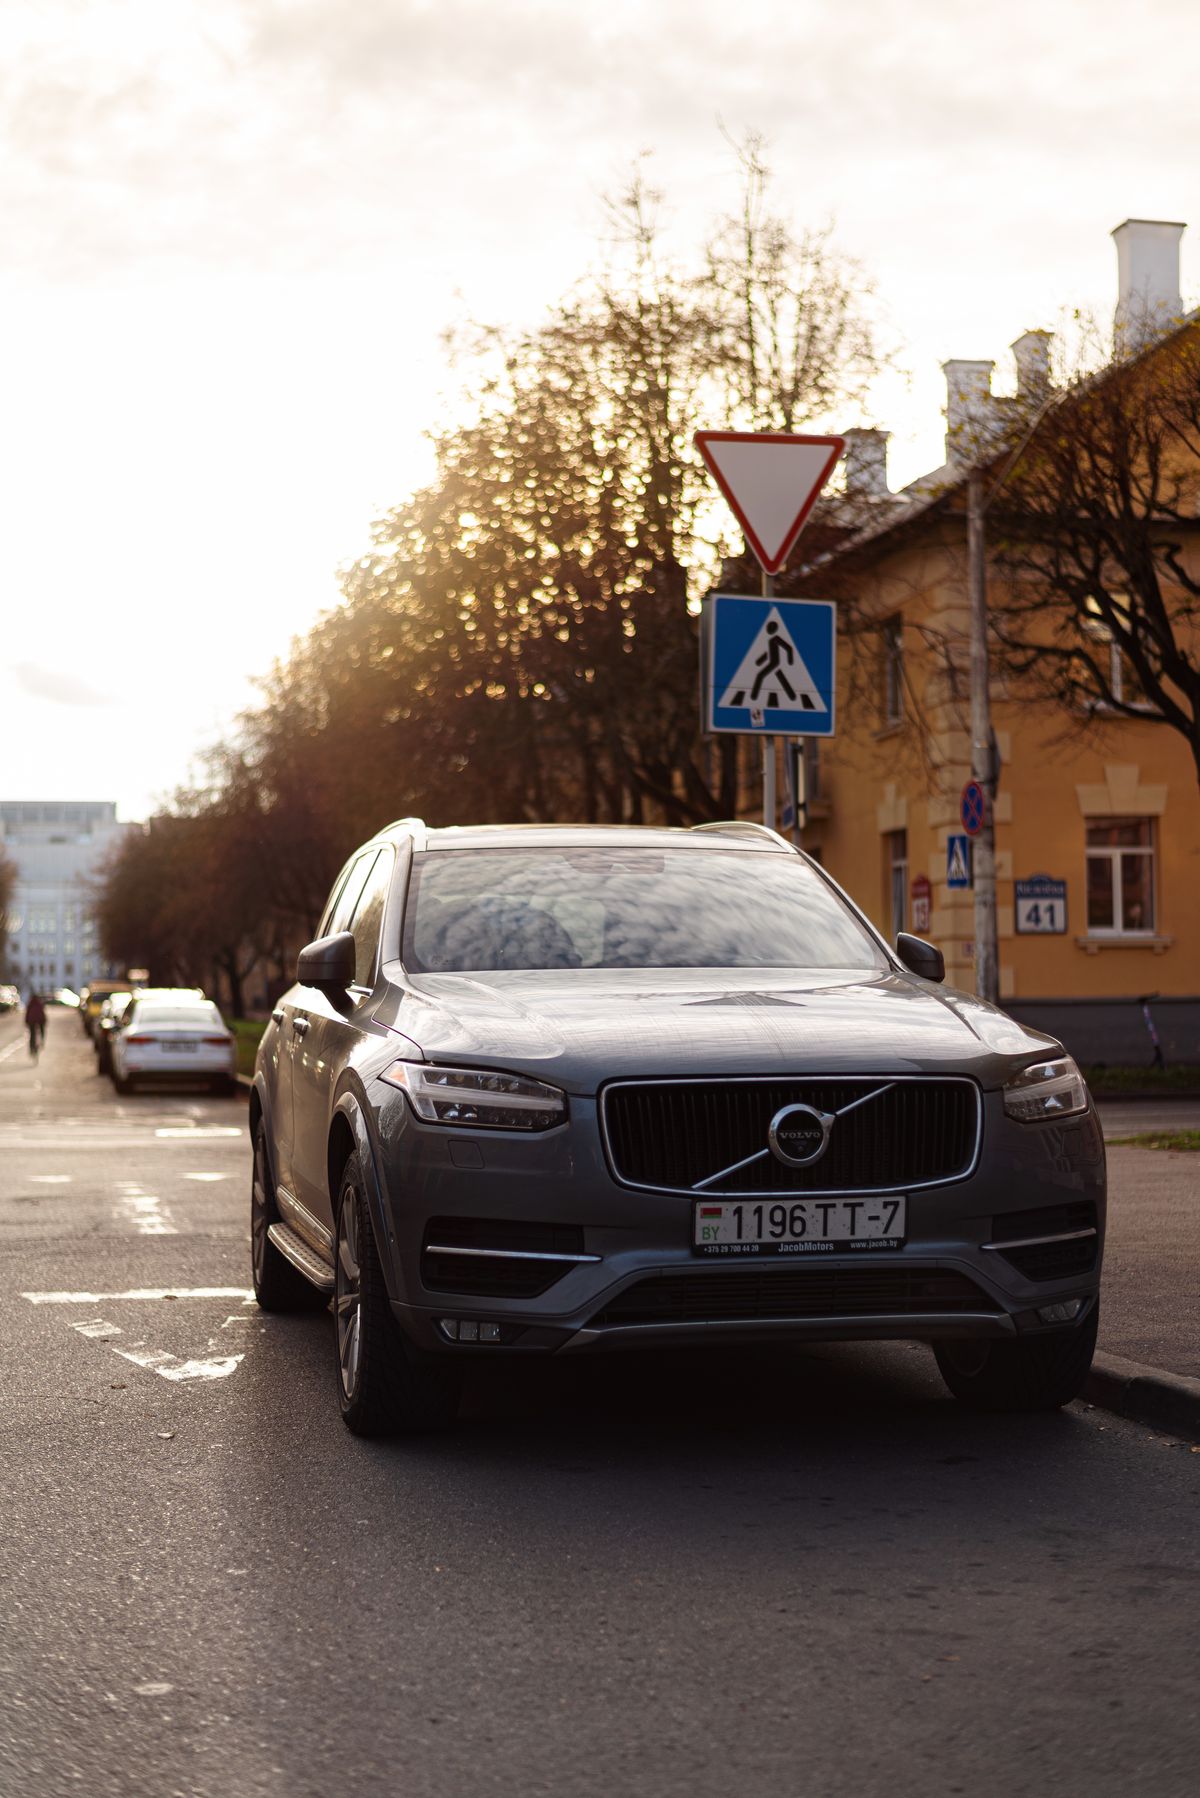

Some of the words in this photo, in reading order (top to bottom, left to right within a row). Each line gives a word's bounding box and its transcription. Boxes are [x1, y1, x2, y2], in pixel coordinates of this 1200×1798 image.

[1025, 903, 1055, 928] 41
[779, 1131, 821, 1139] VOLVO
[733, 1204, 807, 1240] 1196
[702, 1226, 720, 1241] BY
[778, 1242, 834, 1252] JacobMotors
[850, 1239, 898, 1249] www.jacob.by
